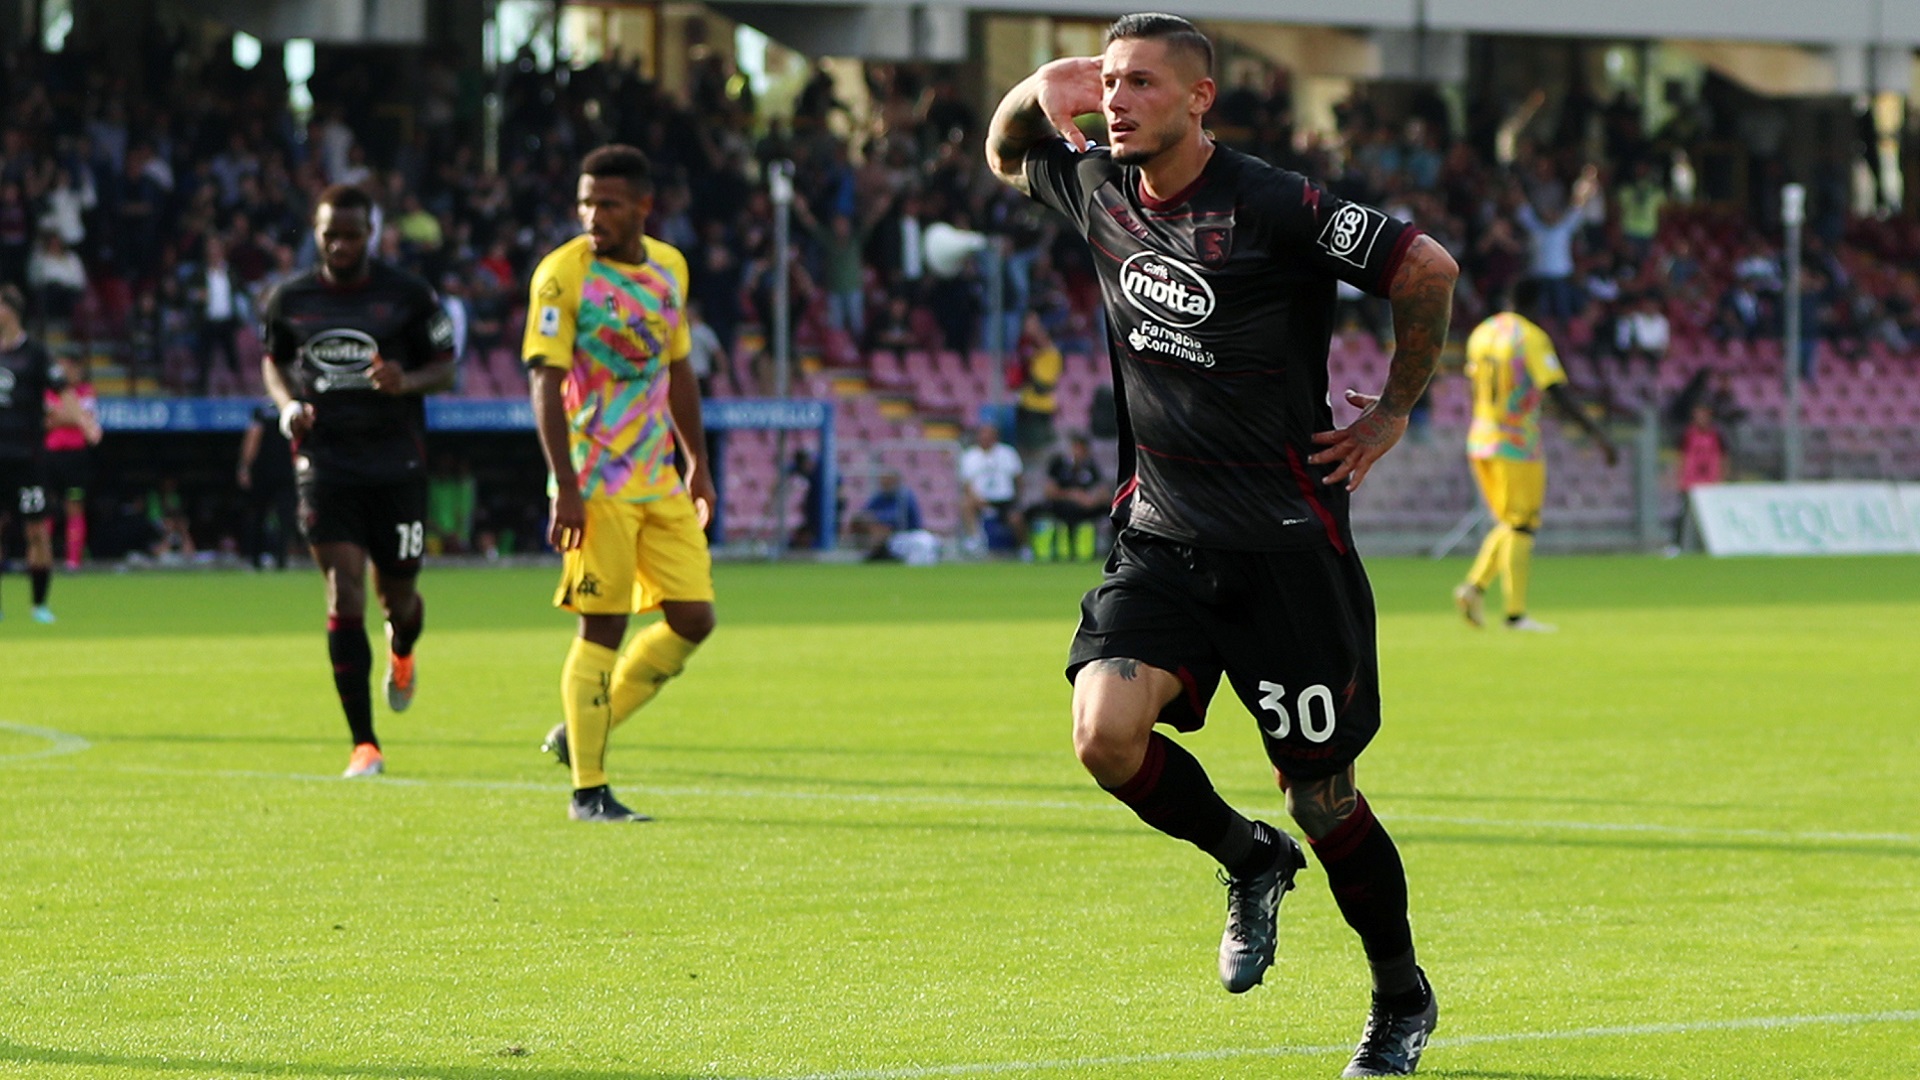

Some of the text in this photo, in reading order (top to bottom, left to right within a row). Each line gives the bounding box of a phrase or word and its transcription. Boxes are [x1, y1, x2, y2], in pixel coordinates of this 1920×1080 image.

[1126, 271, 1206, 316] motta
[1141, 320, 1203, 349] Farmacia
[395, 520, 424, 560] 18
[1258, 680, 1336, 743] 30
